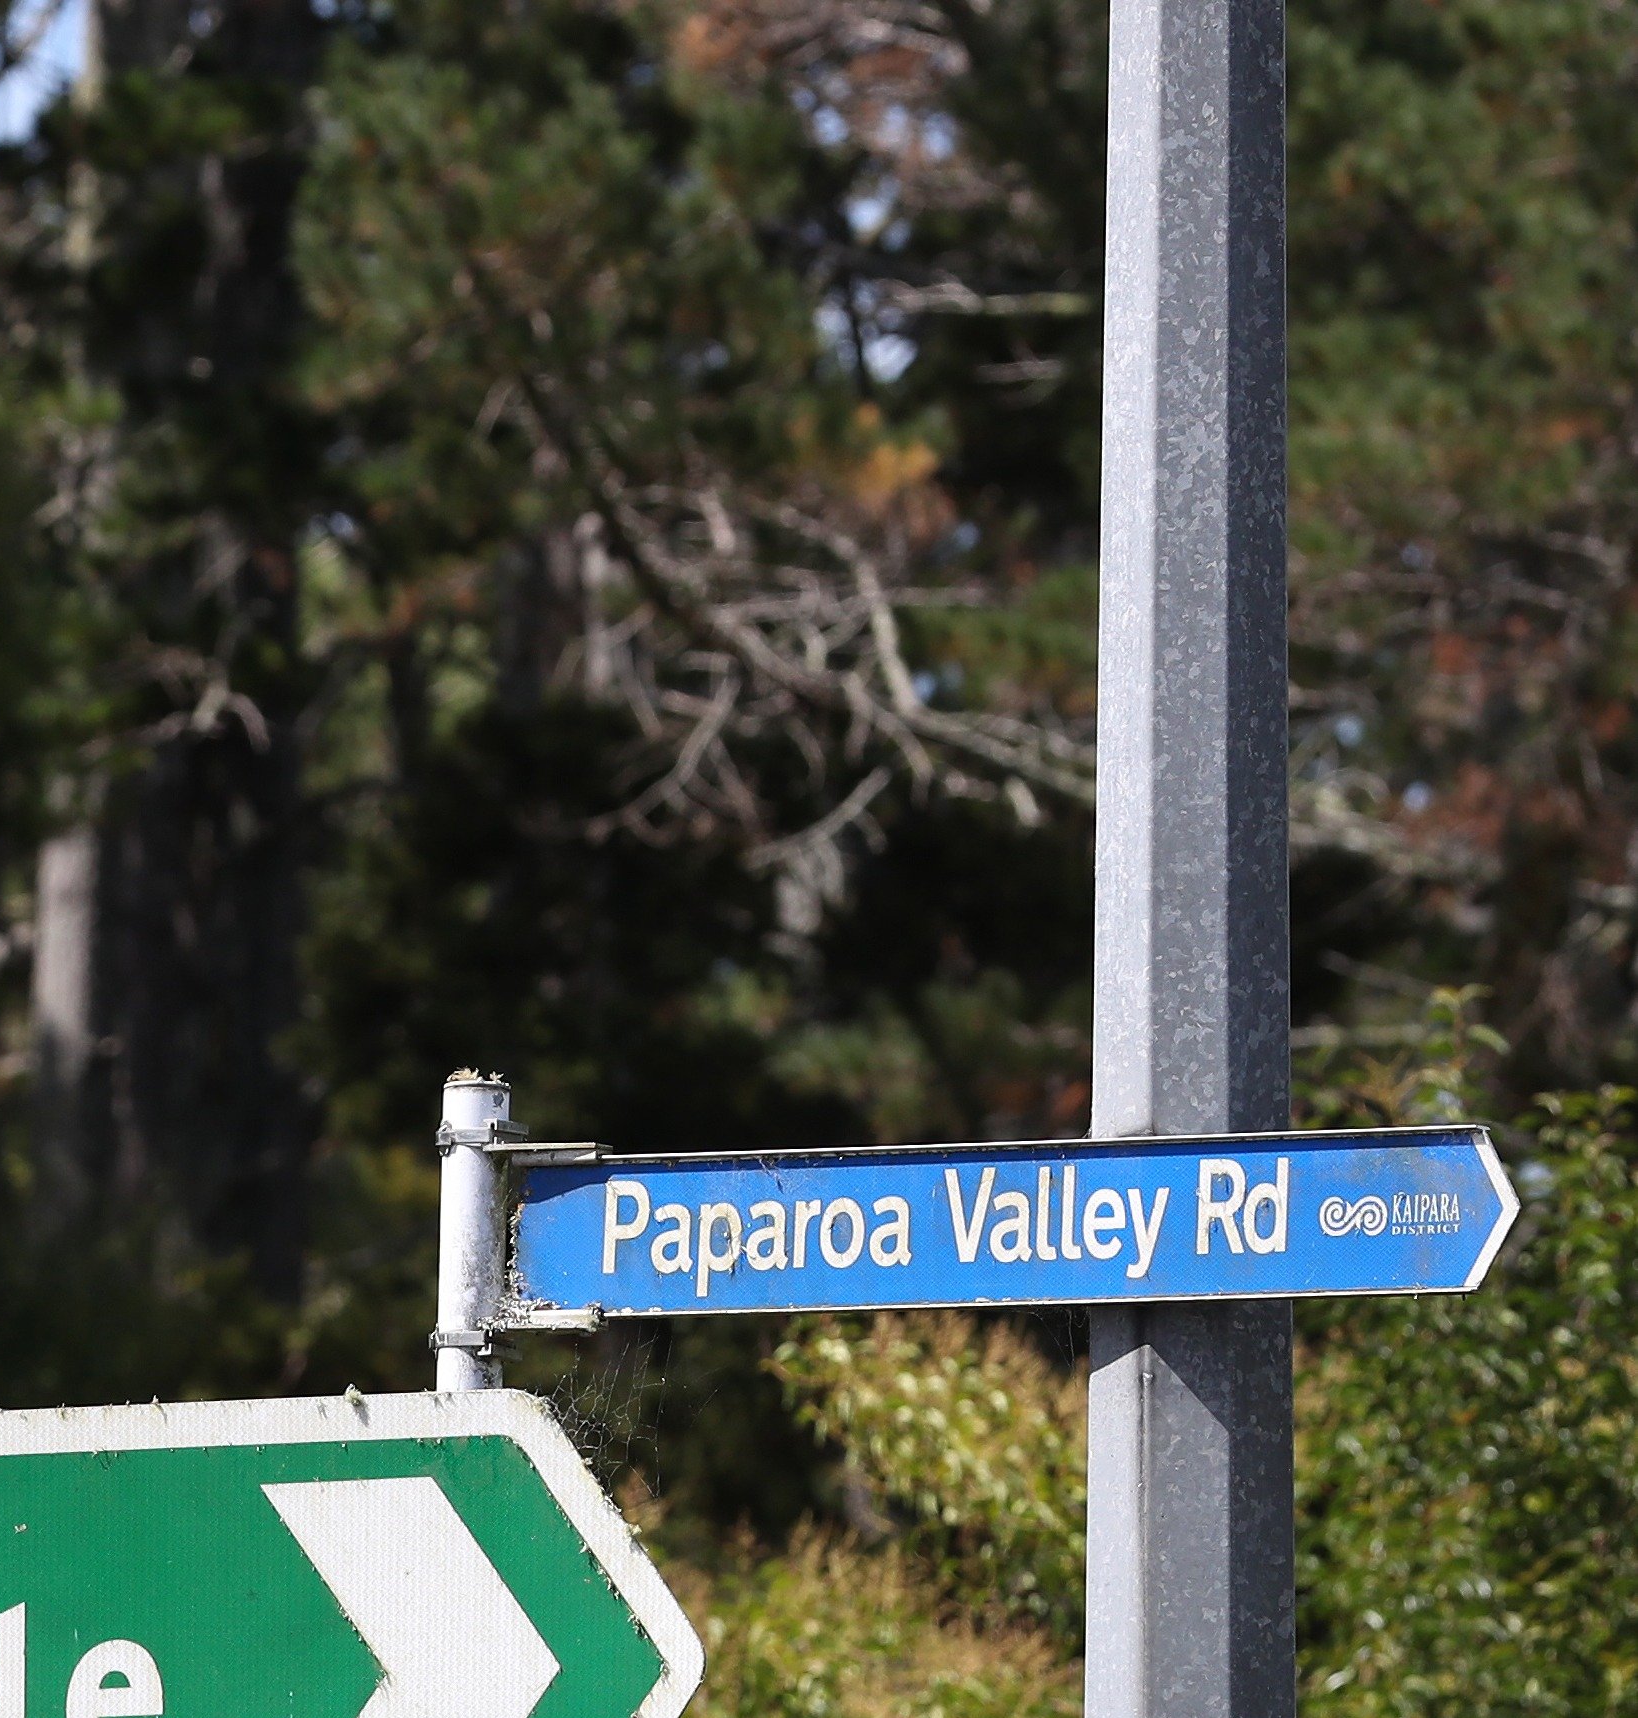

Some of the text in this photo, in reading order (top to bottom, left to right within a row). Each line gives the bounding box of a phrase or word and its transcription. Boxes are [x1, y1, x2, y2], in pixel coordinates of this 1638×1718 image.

[1391, 1193, 1461, 1224] KAIPARA
[602, 1156, 1291, 1298] Paparoa Valley Rd
[1391, 1223, 1461, 1236] DISTRICT
